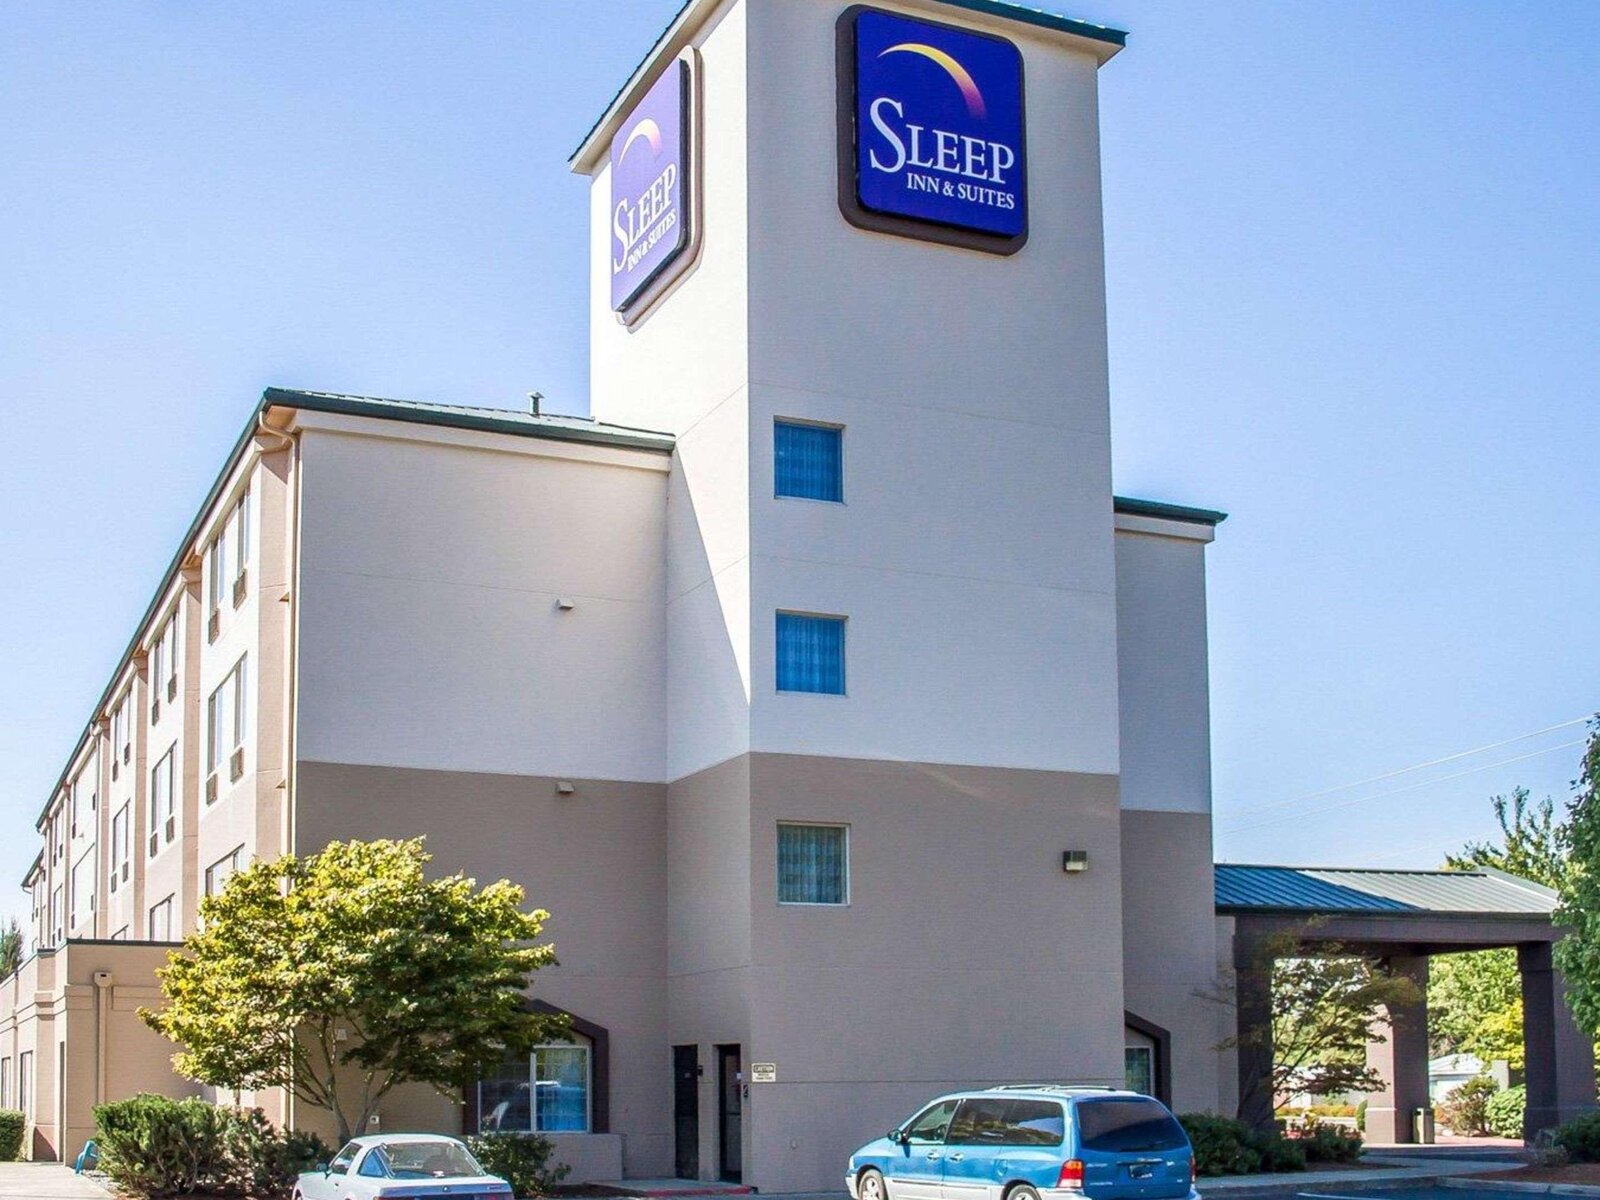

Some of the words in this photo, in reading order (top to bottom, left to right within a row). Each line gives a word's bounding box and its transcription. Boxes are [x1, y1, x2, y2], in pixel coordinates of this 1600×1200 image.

[869, 97, 1015, 184] SLEEP
[613, 163, 677, 275] SLEEP
[907, 172, 940, 194] INN
[942, 182, 955, 197] &
[958, 183, 1015, 210] SUITES
